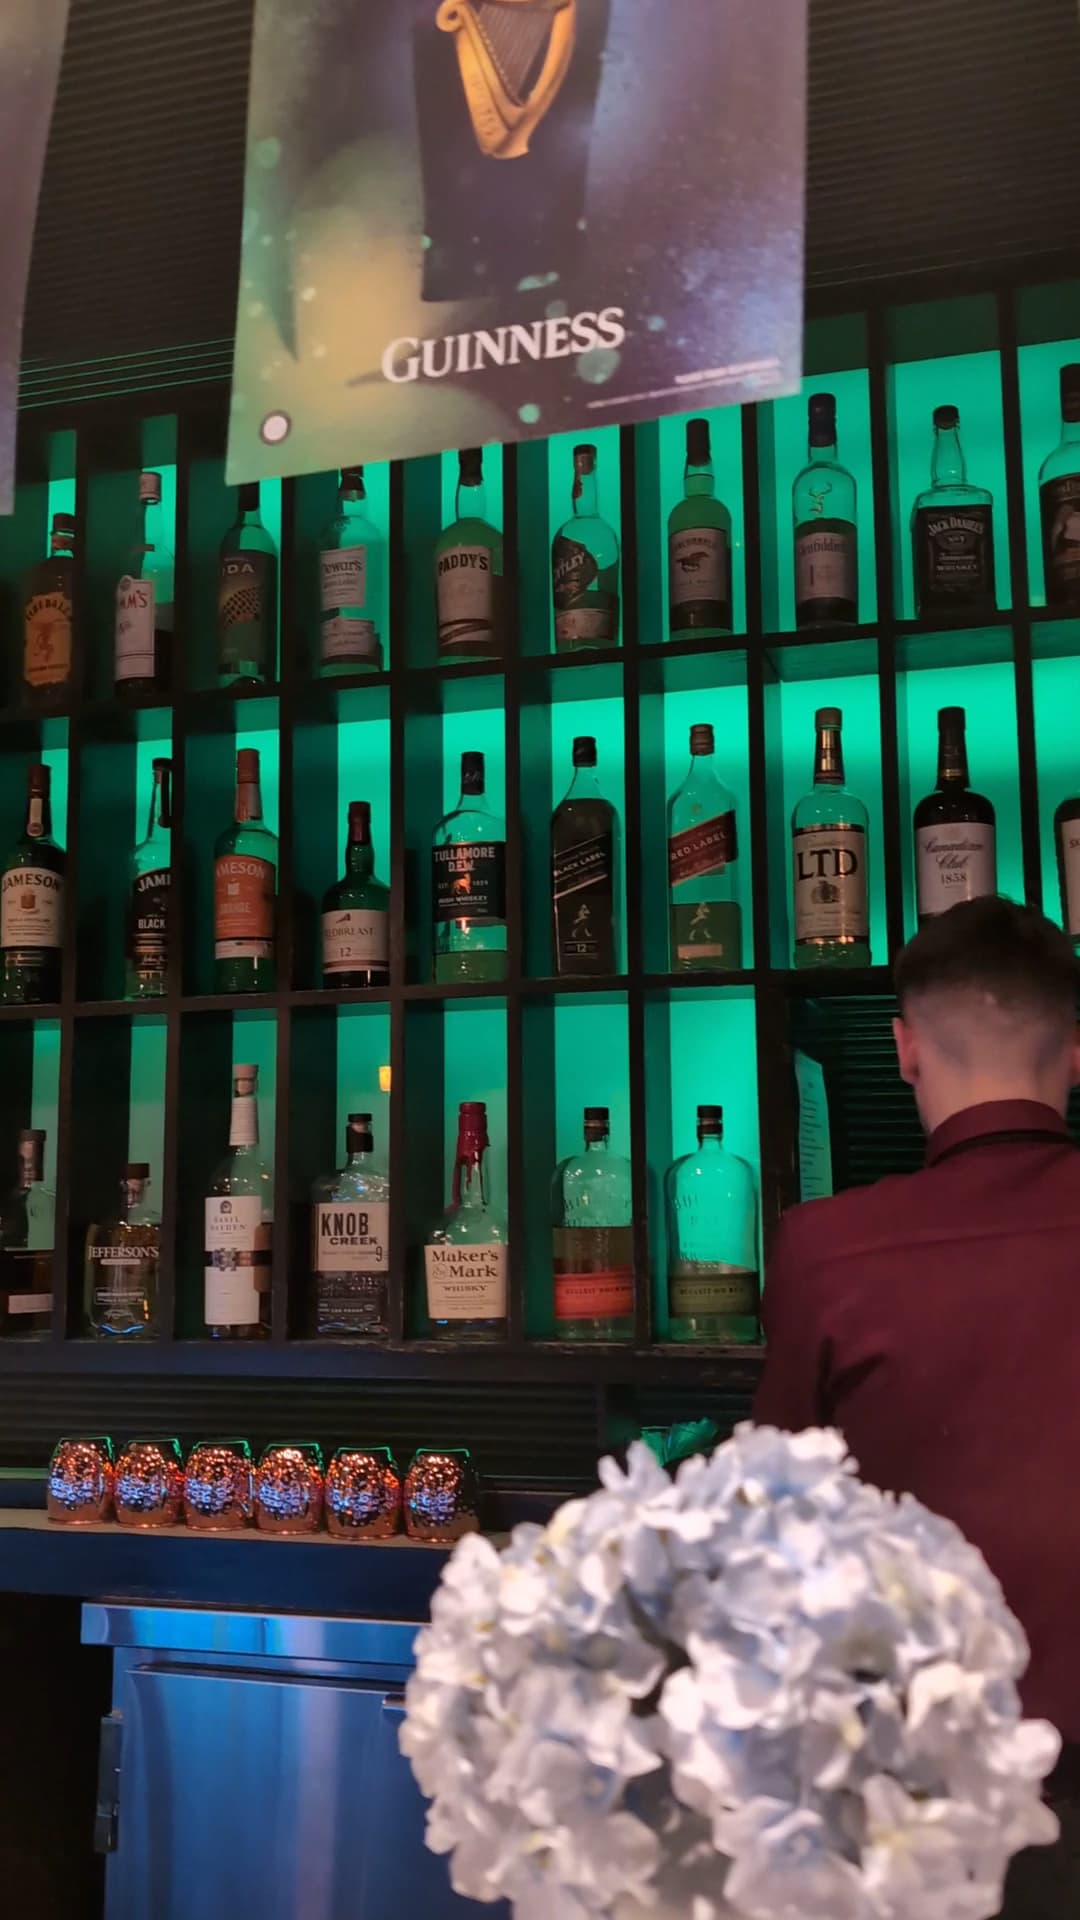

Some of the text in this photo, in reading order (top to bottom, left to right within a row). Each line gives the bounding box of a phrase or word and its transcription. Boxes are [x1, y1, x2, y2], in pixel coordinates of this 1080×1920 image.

[381, 306, 625, 384] GUINNESS
[438, 553, 488, 576] PADDY'S
[670, 846, 692, 861] RED
[692, 831, 727, 850] LABEL
[433, 846, 496, 862] TULLAMORE
[797, 848, 858, 881] LTD
[3, 873, 59, 892] JAMESON
[138, 919, 166, 929] BLACK
[340, 947, 351, 957] 12
[576, 943, 588, 953] 12
[321, 1212, 369, 1237] KNOB
[329, 1236, 378, 1246] CREEK
[88, 1246, 159, 1260] JEFFERSON'S
[376, 1246, 383, 1262] 9
[432, 1250, 499, 1262] Maker's
[450, 1265, 499, 1277] Mark
[443, 1285, 488, 1293] WHISKY
